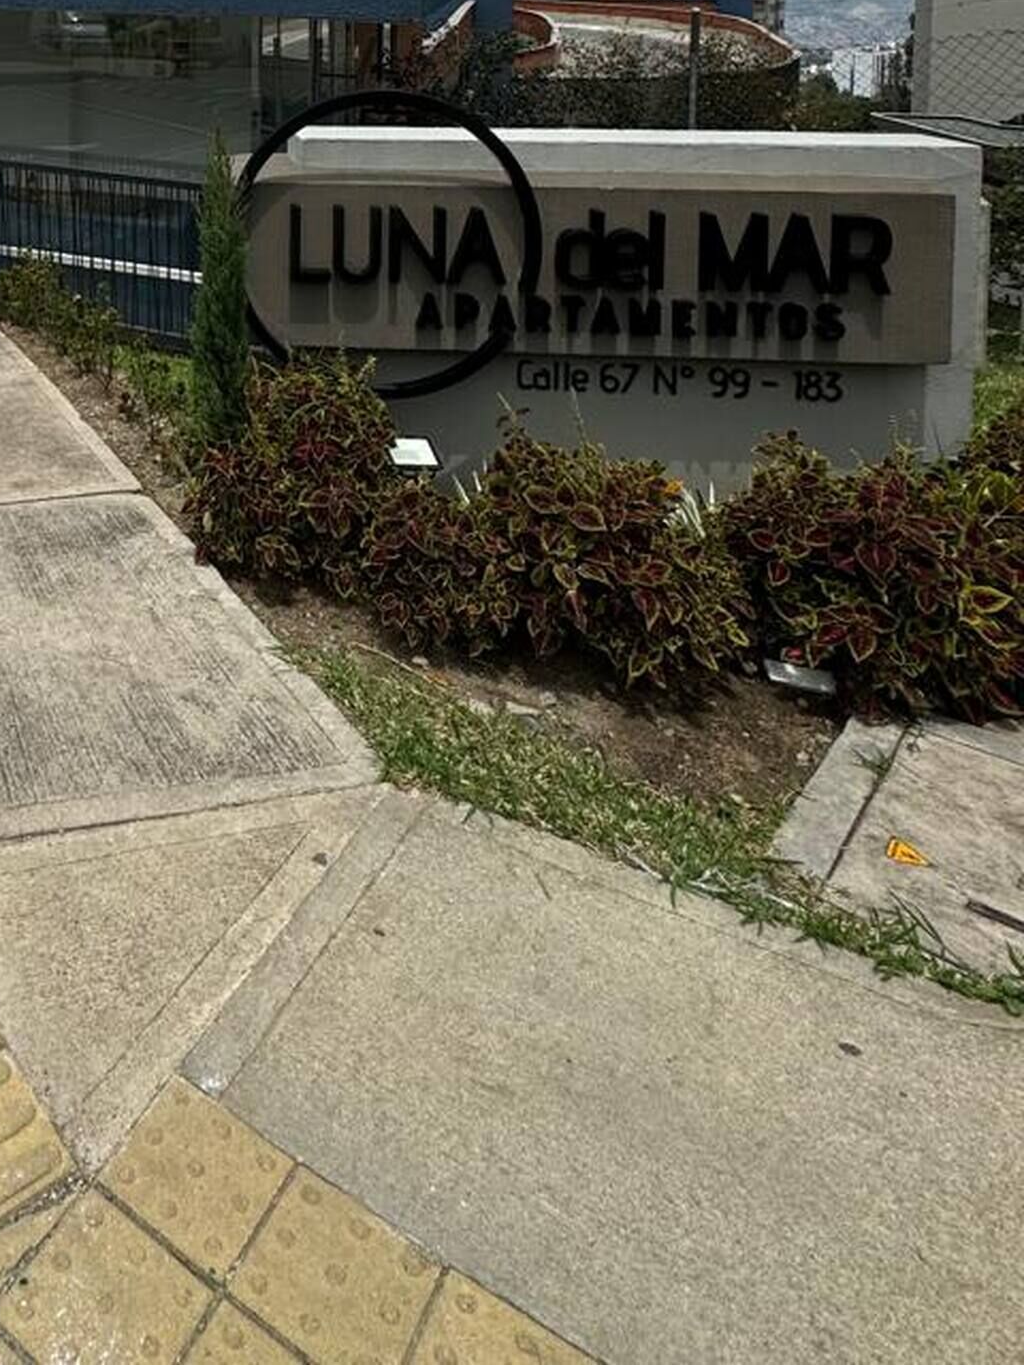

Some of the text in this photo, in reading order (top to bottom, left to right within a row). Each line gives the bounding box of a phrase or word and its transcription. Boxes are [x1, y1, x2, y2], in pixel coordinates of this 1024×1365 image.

[289, 203, 893, 295] LUNA del MAR
[414, 291, 847, 341] APARTAMENTOS
[515, 359, 590, 392] Calle
[599, 363, 640, 394] 67
[707, 367, 752, 400] 99
[792, 369, 844, 403] 183
